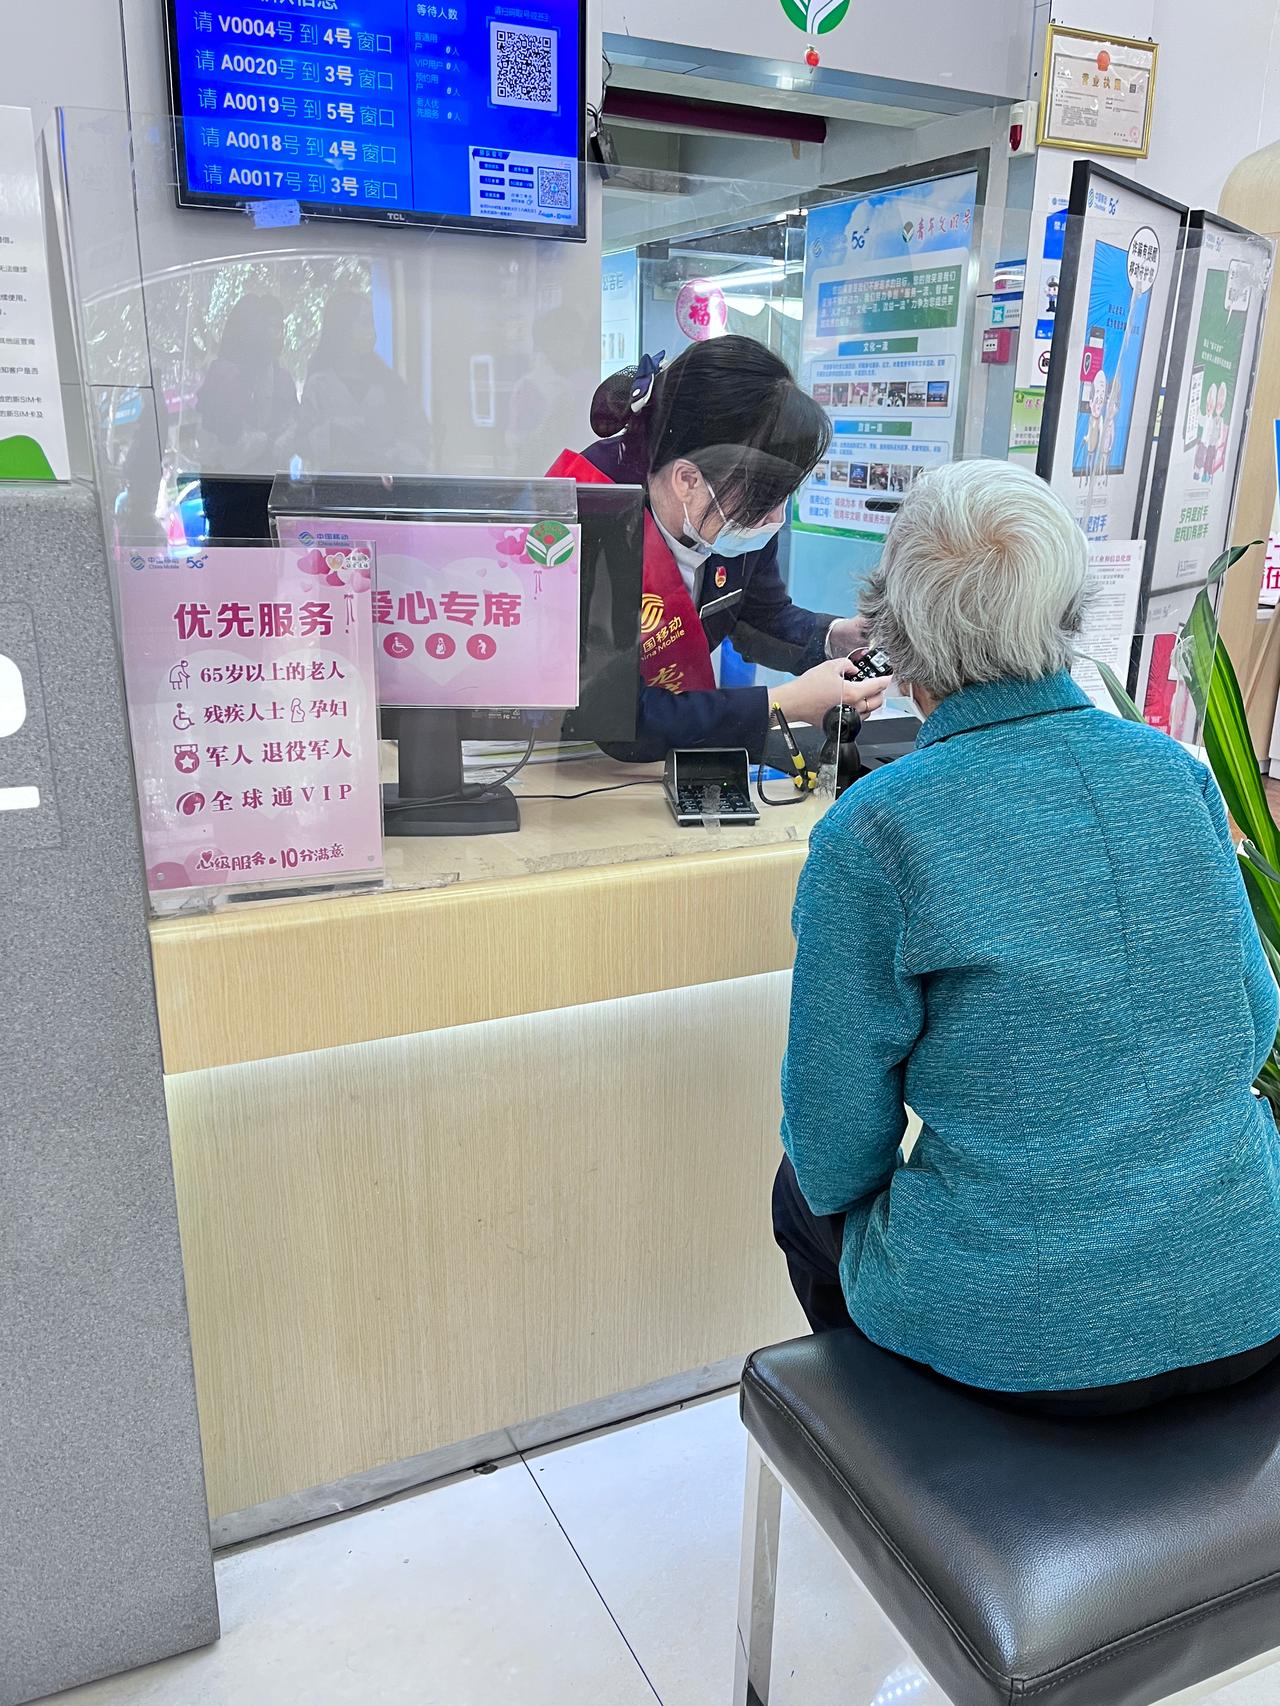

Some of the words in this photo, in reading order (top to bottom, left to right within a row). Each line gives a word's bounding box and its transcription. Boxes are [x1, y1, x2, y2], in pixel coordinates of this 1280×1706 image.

[416, 4, 458, 21] 等待人数
[194, 10, 212, 32] 请
[218, 15, 295, 42] V0004号
[300, 23, 318, 45] 到
[324, 28, 352, 48] 4号
[357, 32, 392, 53] 窗口
[196, 49, 215, 71] 请
[221, 54, 296, 80] A0020号
[302, 61, 320, 83] 到
[325, 66, 353, 86] 3号
[358, 69, 393, 90] 窗口
[415, 60, 443, 70] VIP用户
[1082, 72, 1122, 91] 营业执照
[198, 88, 217, 109] 请
[223, 93, 298, 118] A0019号
[304, 99, 321, 120] 到
[327, 103, 355, 123] 5号
[360, 106, 394, 128] 窗口
[201, 127, 220, 148] 请
[226, 131, 300, 155] A0018号
[306, 137, 324, 158] 到
[329, 140, 357, 161] 4号
[362, 143, 396, 165] 窗口
[204, 164, 222, 186] 请
[229, 168, 302, 192] A0017号
[308, 173, 326, 194] 到
[331, 176, 358, 197] 3号
[364, 180, 397, 200] 窗口
[387, 212, 405, 221] TCL
[1132, 240, 1158, 263] 诈骗有提醒
[1179, 505, 1209, 525] 岁月是对手
[173, 602, 334, 640] 优先服务
[643, 616, 682, 653] 国移动
[658, 629, 685, 652] Mobile
[200, 660, 345, 684] 65岁以上的老人
[203, 702, 284, 724] 残疾人士
[310, 699, 348, 719] 孕妇
[206, 744, 253, 767] 军人
[262, 738, 352, 763] 退役军人
[281, 843, 344, 868] 10分满意
